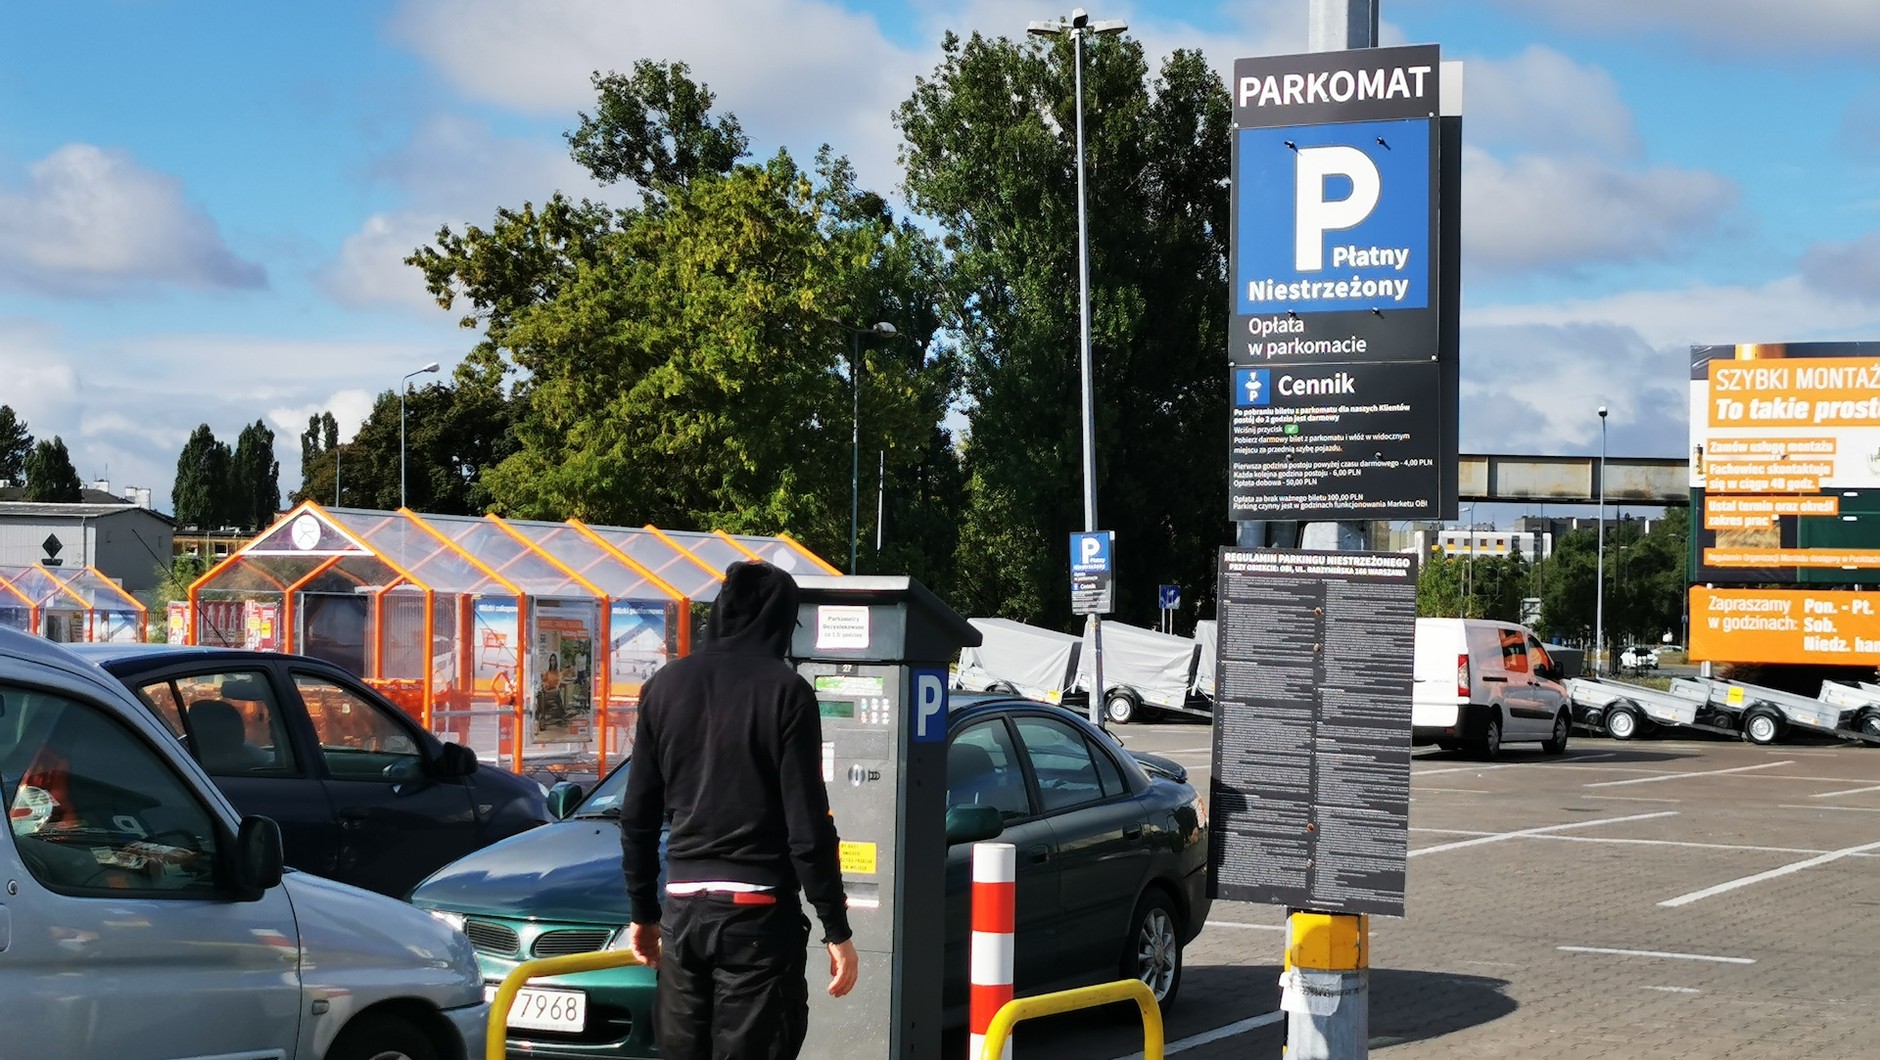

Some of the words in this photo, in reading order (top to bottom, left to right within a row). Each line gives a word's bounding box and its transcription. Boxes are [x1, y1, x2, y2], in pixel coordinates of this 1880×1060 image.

[1239, 66, 1431, 107] PARKOMAT
[1295, 146, 1381, 271] P
[1333, 245, 1409, 269] Płatny
[1248, 275, 1409, 301] Niestrzeżony
[1248, 317, 1304, 337] Opłata
[1248, 342, 1262, 355] w
[1266, 335, 1366, 359] parkomacie
[1278, 372, 1355, 396] Cennik
[1715, 367, 1789, 391] SZYBKI
[1271, 415, 1293, 424] godzin
[1294, 415, 1306, 423] jest
[1307, 414, 1340, 423] darmowy
[1301, 406, 1337, 416] parkomatu
[1338, 405, 1350, 413] dla
[1350, 405, 1378, 413] naszych
[1380, 403, 1410, 412] Klientów
[1716, 398, 1744, 420] To
[1750, 397, 1809, 420] takie
[1813, 397, 1880, 424] prost
[1257, 425, 1282, 435] przycisk
[1258, 436, 1288, 444] darmowy
[1309, 435, 1344, 443] parkomatu
[1373, 433, 1410, 441] widocznym
[1254, 471, 1277, 479] kolejna
[1278, 470, 1303, 478] godzina
[1304, 469, 1328, 478] postoju
[1333, 469, 1347, 477] 6,00
[1263, 462, 1288, 470] godzina
[1289, 462, 1312, 470] postoju
[1313, 461, 1340, 469] powyżej
[1360, 460, 1399, 468] darmowego
[1404, 459, 1418, 467] 4,00
[1233, 503, 1257, 511] Parking
[1281, 502, 1293, 511] jest
[1300, 501, 1333, 510] godzinach
[1334, 500, 1386, 509] funkcjonowania
[1081, 537, 1100, 564] P
[1224, 553, 1277, 563] REGULAMIN
[1278, 554, 1325, 565] PARKINGU
[1327, 555, 1411, 568] NIESTRZEŻONEGO
[1229, 563, 1246, 571] PRZY
[1368, 568, 1407, 576] WARSZAWA
[1708, 596, 1792, 615] Zapraszamy
[1804, 598, 1838, 614] Pon.
[1852, 599, 1874, 615] Pt.
[1708, 617, 1719, 629] w
[1722, 615, 1798, 632] godzinach:
[1804, 617, 1837, 633] Sob.
[1804, 636, 1850, 652] Niedz.
[917, 674, 943, 737] P
[521, 993, 577, 1021] 7968
